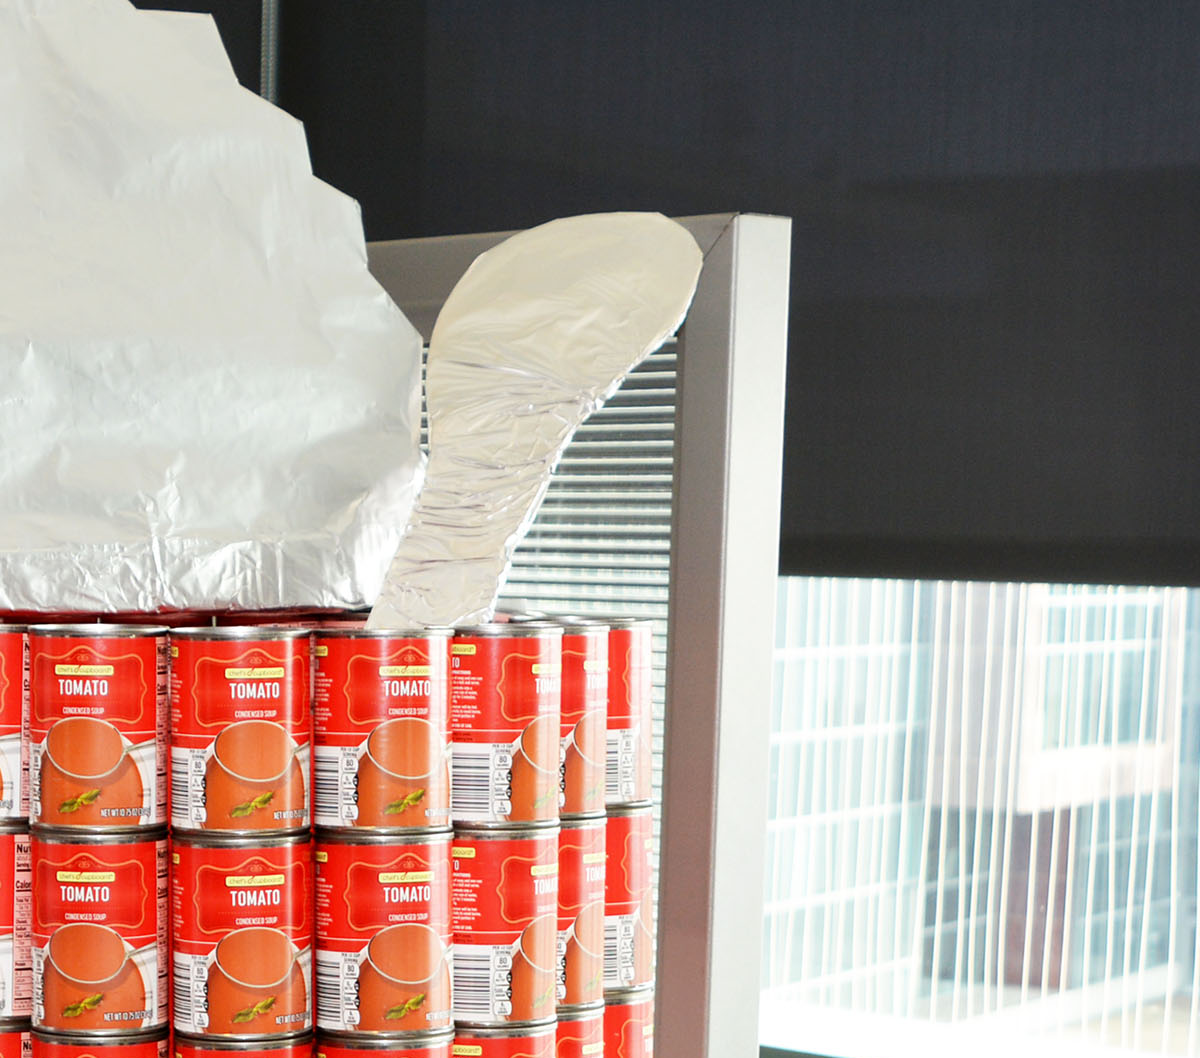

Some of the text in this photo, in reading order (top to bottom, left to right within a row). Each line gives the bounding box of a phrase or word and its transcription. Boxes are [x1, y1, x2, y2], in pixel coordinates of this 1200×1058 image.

[59, 680, 108, 696] TOMATO
[229, 682, 280, 699] TOMATO
[384, 680, 431, 697] TOMATO
[234, 709, 278, 718] CONDENSED SOUP
[61, 886, 109, 902] TOMATO
[230, 889, 280, 906] TOMATO
[383, 886, 431, 903] TOMATO
[65, 913, 107, 921] CONDENSED SOUP
[235, 916, 278, 926] CONDENSED SOUP
[388, 912, 429, 922] CONDENSED SOUP
